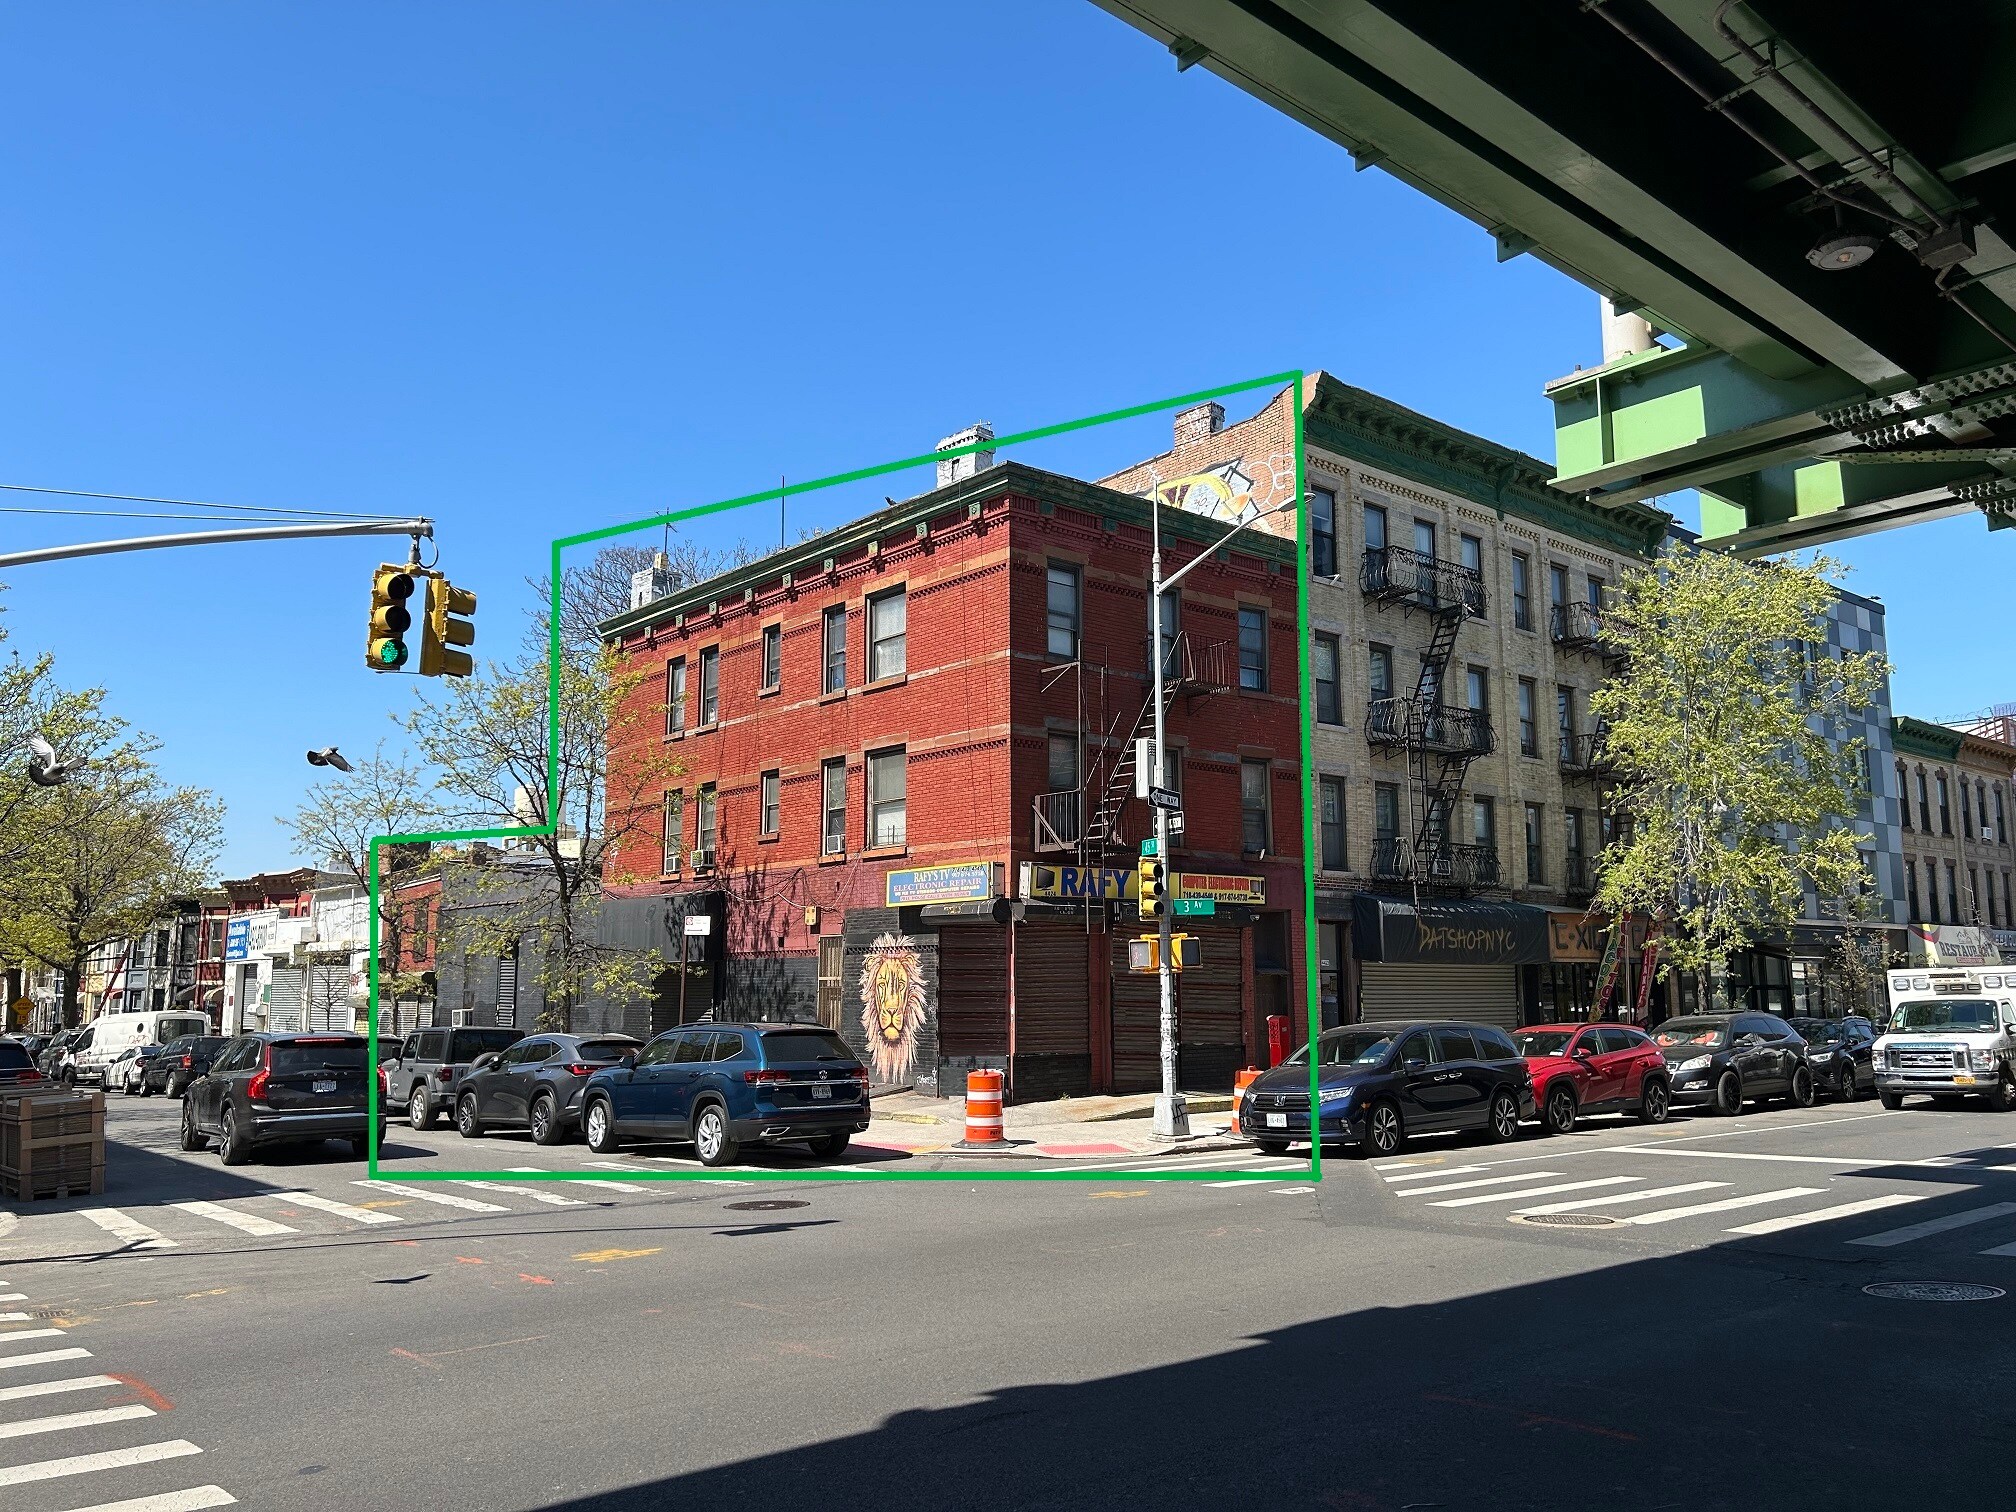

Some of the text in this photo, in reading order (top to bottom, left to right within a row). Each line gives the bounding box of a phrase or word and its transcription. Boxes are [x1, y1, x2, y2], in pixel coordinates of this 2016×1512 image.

[914, 868, 950, 883] RAFY'S TV
[1061, 867, 1131, 898] RAFY
[1182, 875, 1207, 889] COMPUTER
[1208, 876, 1234, 890] ELECTRONIC
[893, 877, 982, 892] ELECTRONIC REPAIR
[1183, 901, 1190, 913] 3
[1419, 922, 1517, 954] DATSHOPNYC
